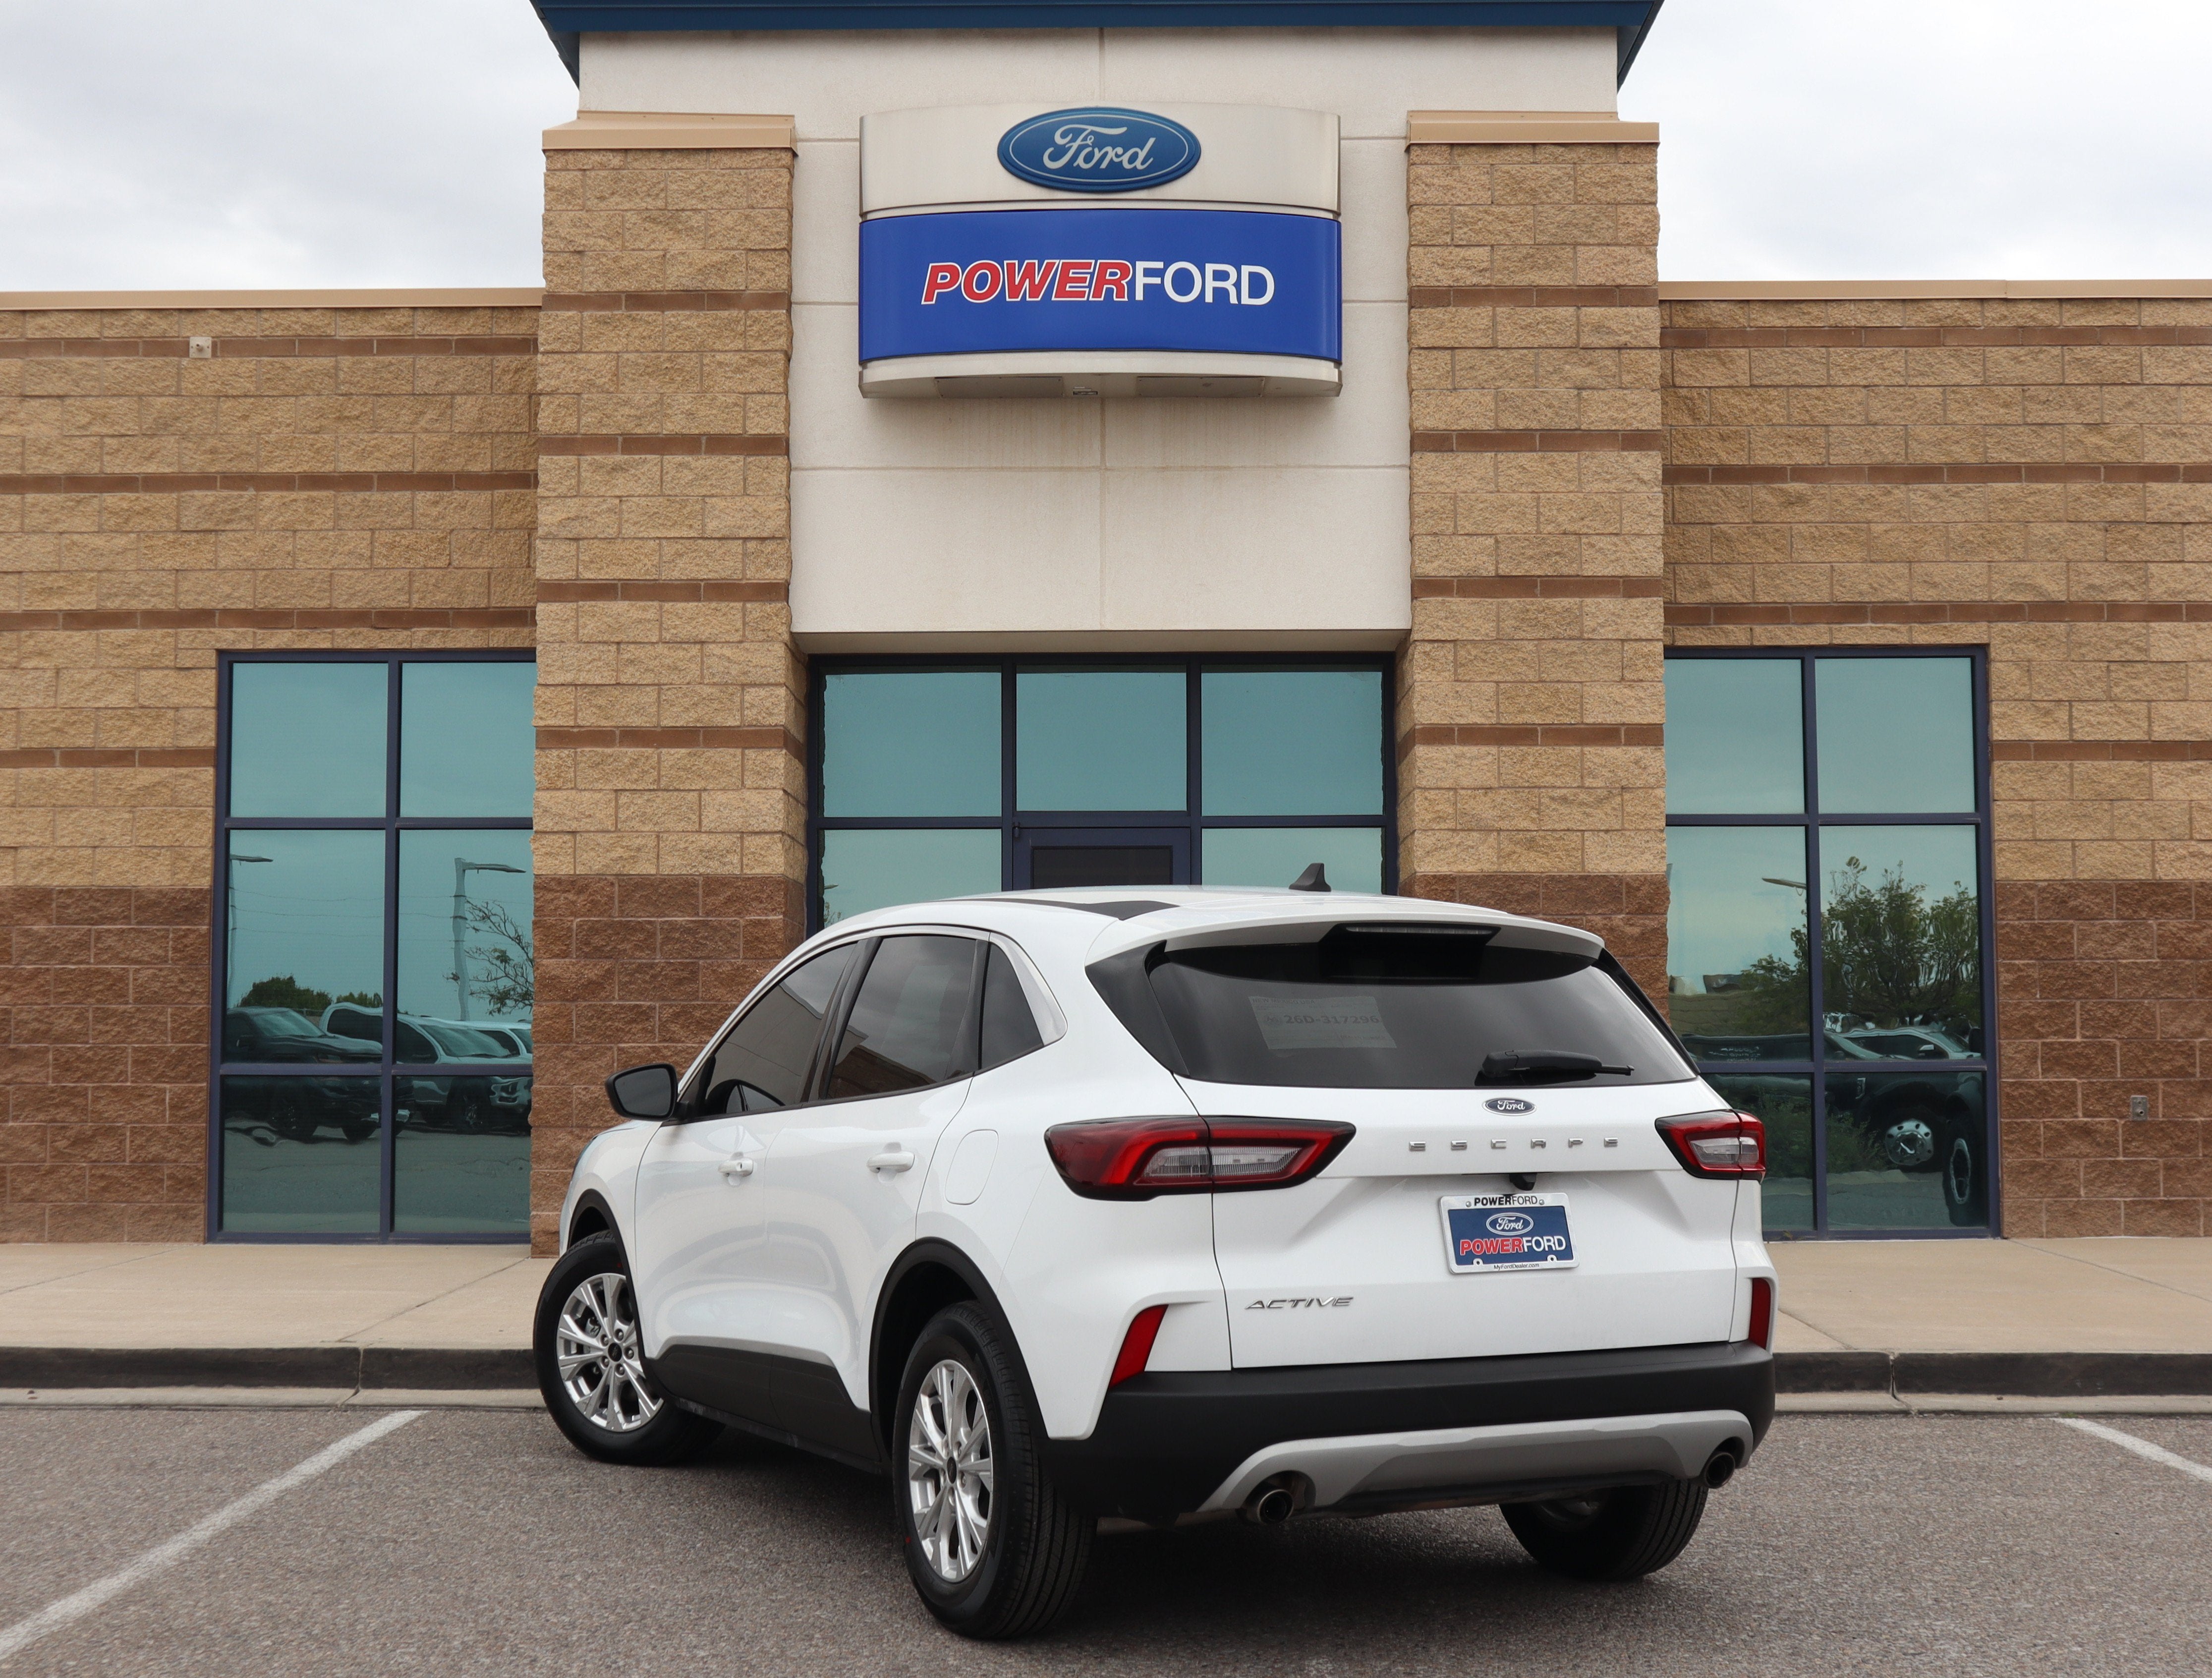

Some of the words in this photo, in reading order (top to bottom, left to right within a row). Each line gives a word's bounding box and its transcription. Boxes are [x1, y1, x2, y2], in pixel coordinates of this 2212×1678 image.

[1043, 123, 1156, 171] Ford
[921, 259, 1275, 306] POWERFORD
[1284, 1015, 1380, 1024] 26D-317296
[1497, 1100, 1526, 1110] Ford
[1409, 1137, 1619, 1151] ESCAPE
[1474, 1195, 1537, 1206] POWERFORD
[1496, 1216, 1524, 1230] Ford
[1460, 1236, 1566, 1256] POWERFORD
[1494, 1263, 1539, 1271] MyFordDealer.com
[1245, 1297, 1354, 1310] ACTIVE
